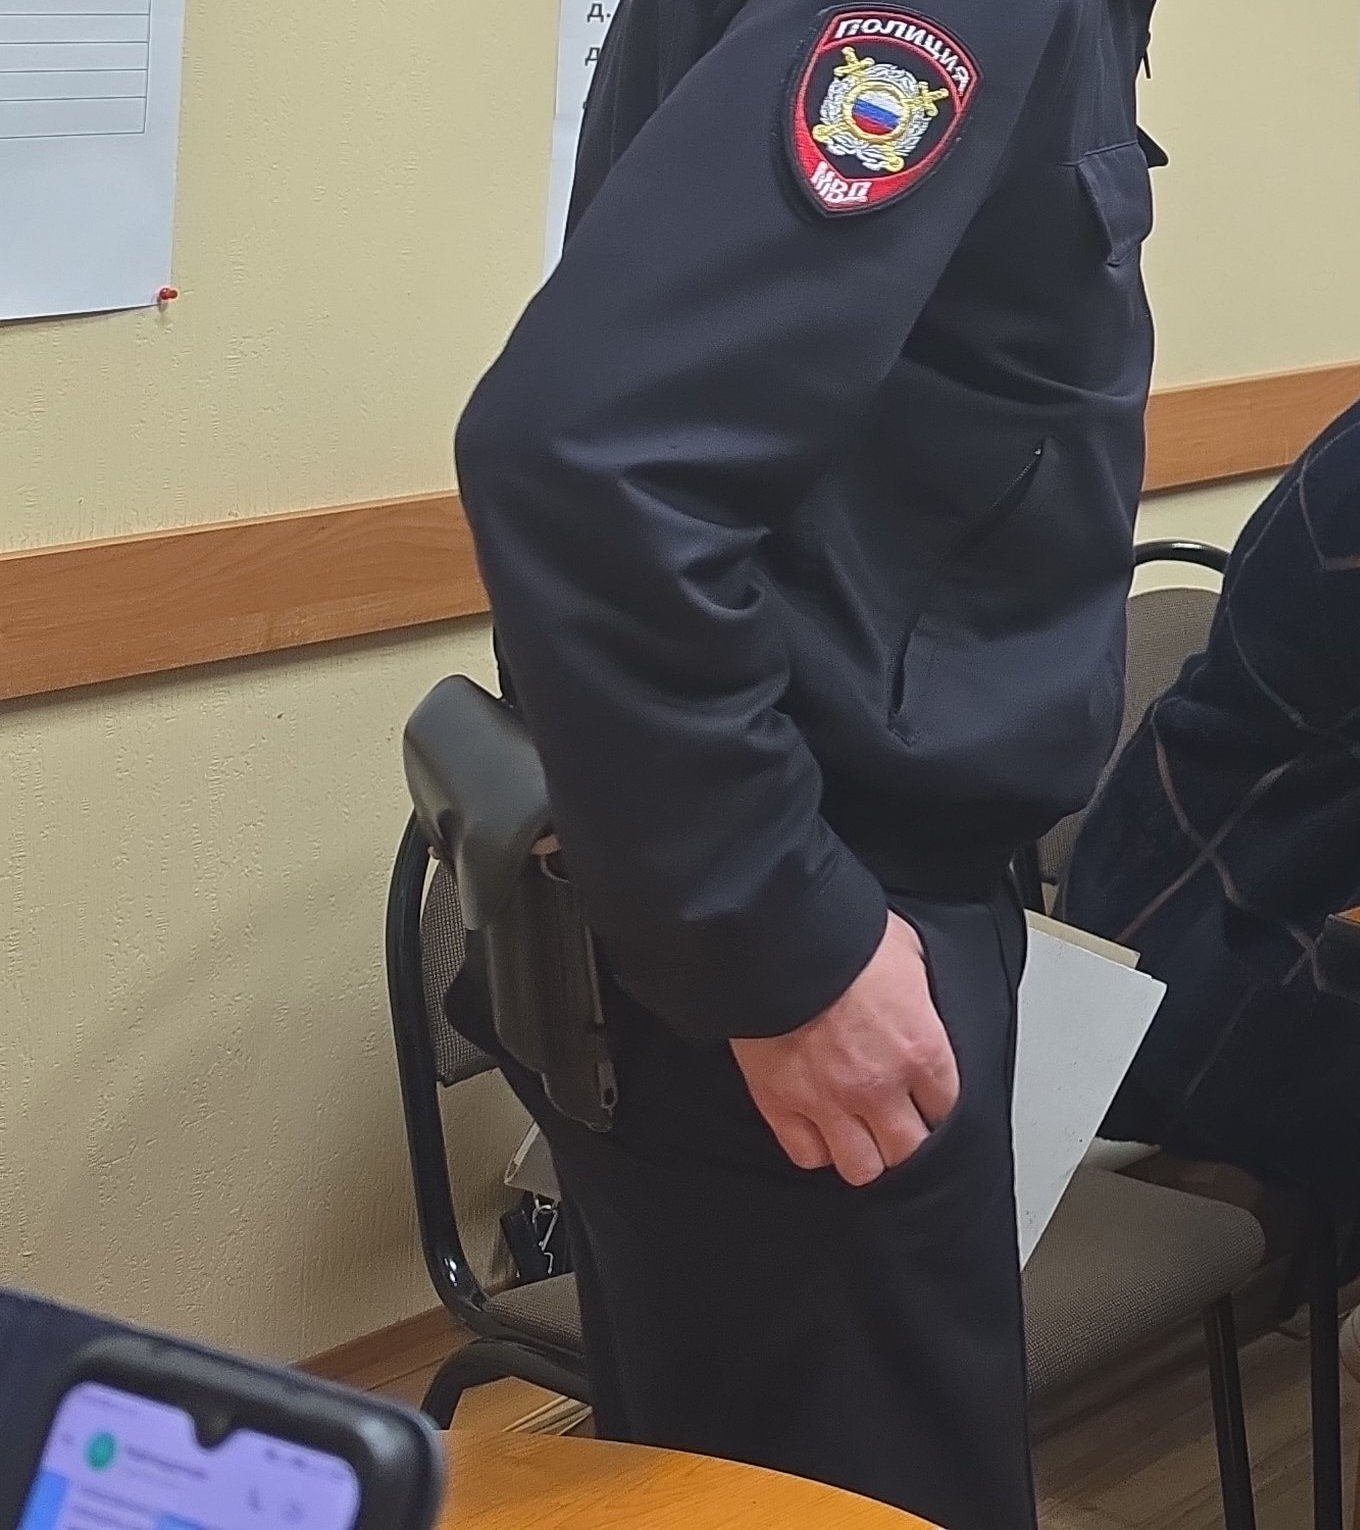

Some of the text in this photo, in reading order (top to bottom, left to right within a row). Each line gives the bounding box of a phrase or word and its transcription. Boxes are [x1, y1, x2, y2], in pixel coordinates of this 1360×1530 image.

[587, 3, 611, 22] д.
[835, 18, 971, 97] ПОЛИЦИЯ
[810, 161, 872, 203] МВД
